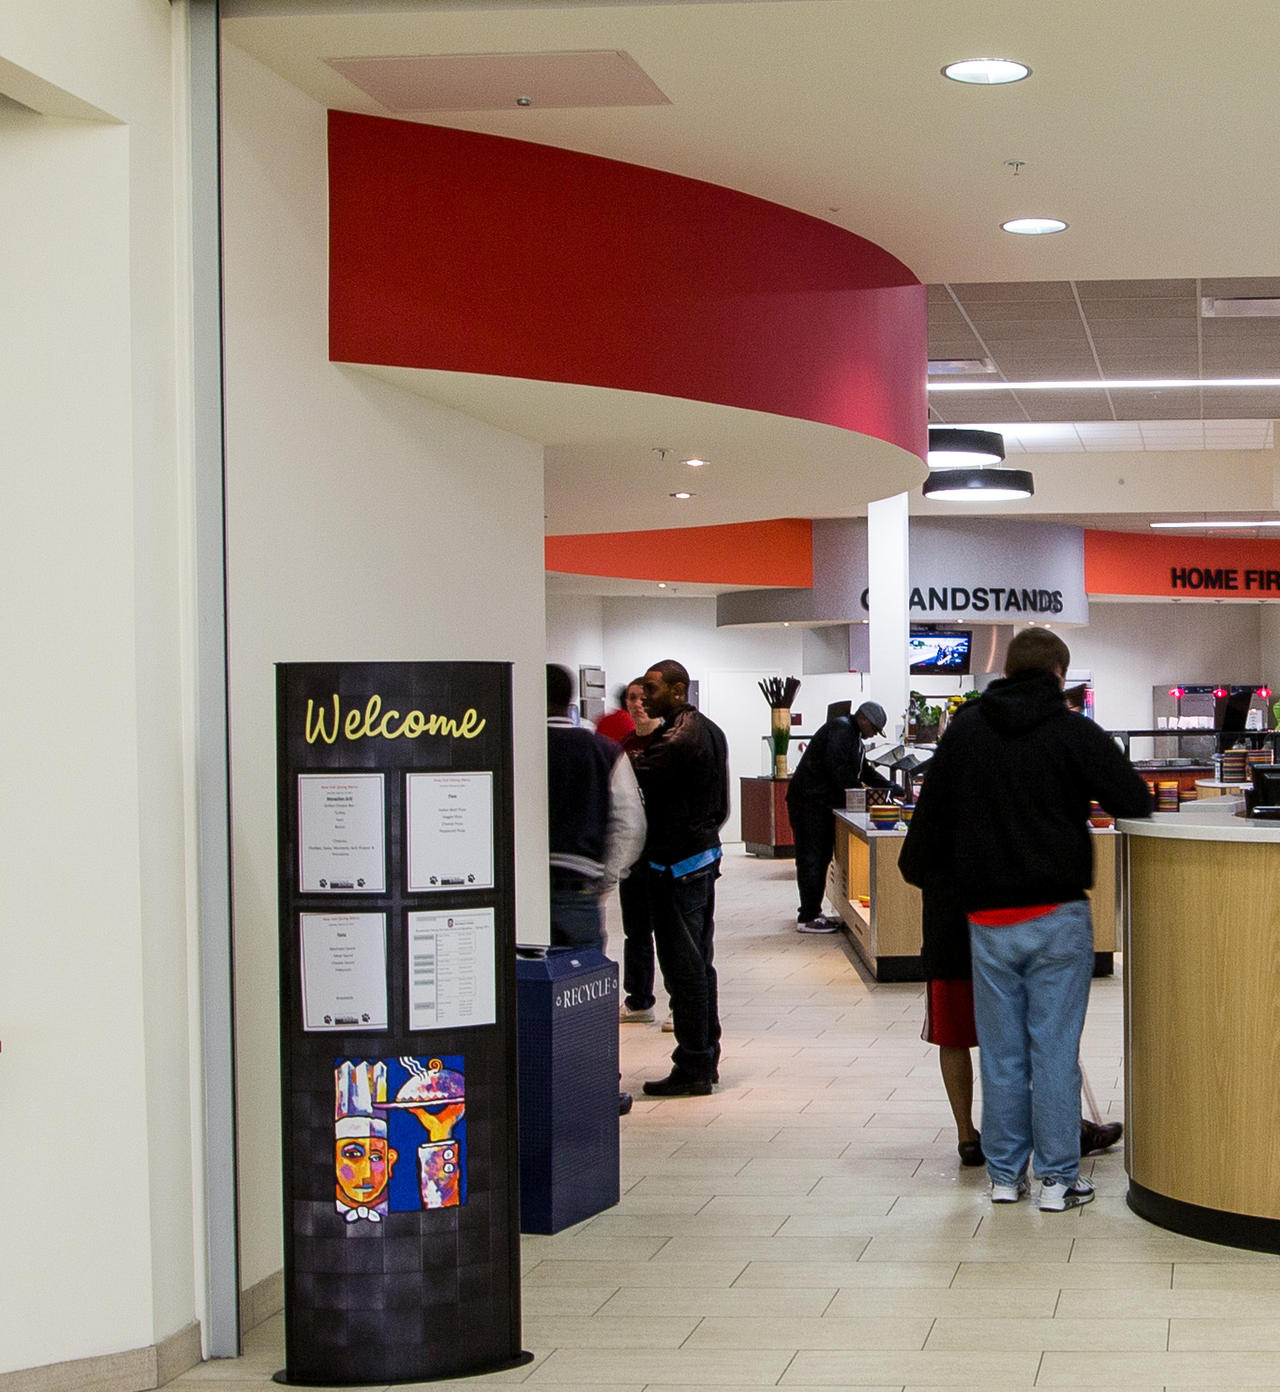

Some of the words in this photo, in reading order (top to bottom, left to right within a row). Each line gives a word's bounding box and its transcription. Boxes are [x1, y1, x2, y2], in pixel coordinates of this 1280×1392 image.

[1170, 566, 1238, 591] HOME
[860, 586, 1063, 613] ANDSTANDS
[305, 694, 487, 744] Welcome
[563, 977, 611, 1009] RECYCLE
